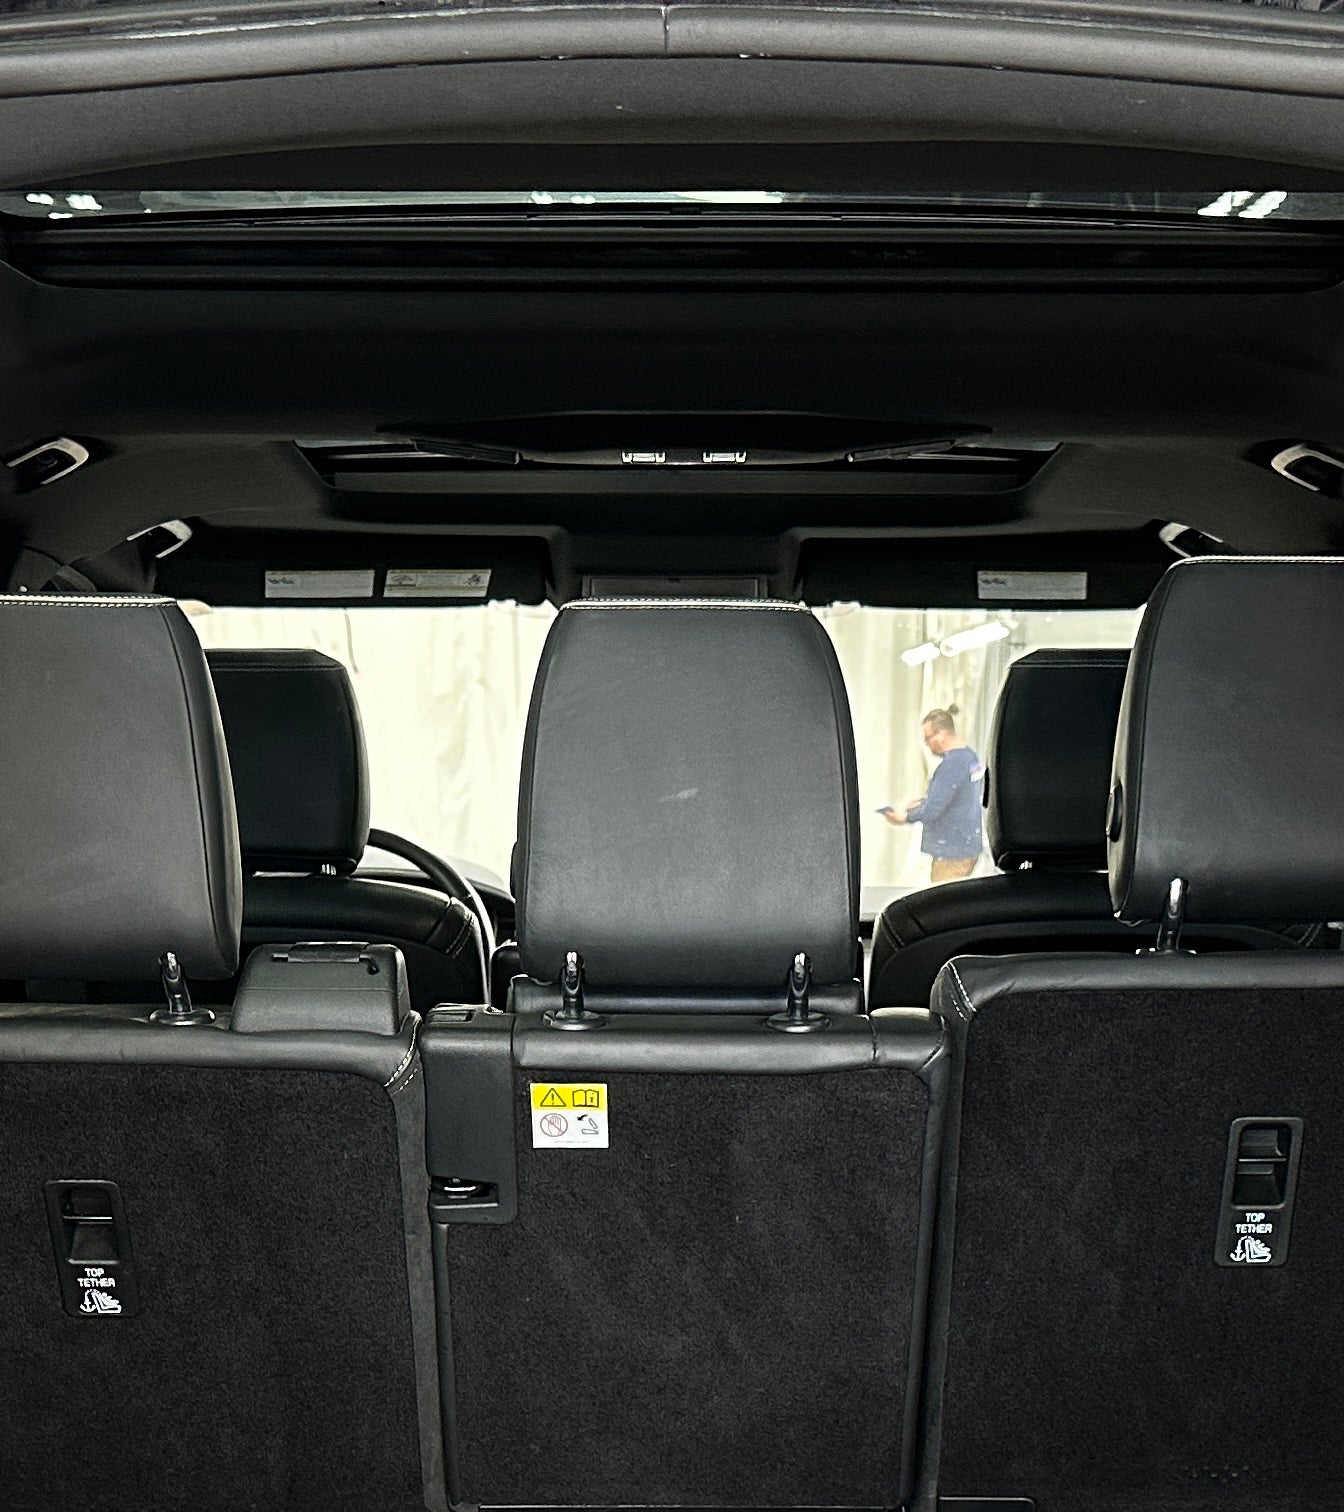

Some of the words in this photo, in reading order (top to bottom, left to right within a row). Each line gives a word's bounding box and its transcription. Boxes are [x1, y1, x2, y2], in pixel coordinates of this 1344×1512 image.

[1245, 1212, 1266, 1222] TOP
[1235, 1224, 1273, 1234] TETHER
[84, 1268, 105, 1277] TOP
[77, 1278, 116, 1288] TETHER
